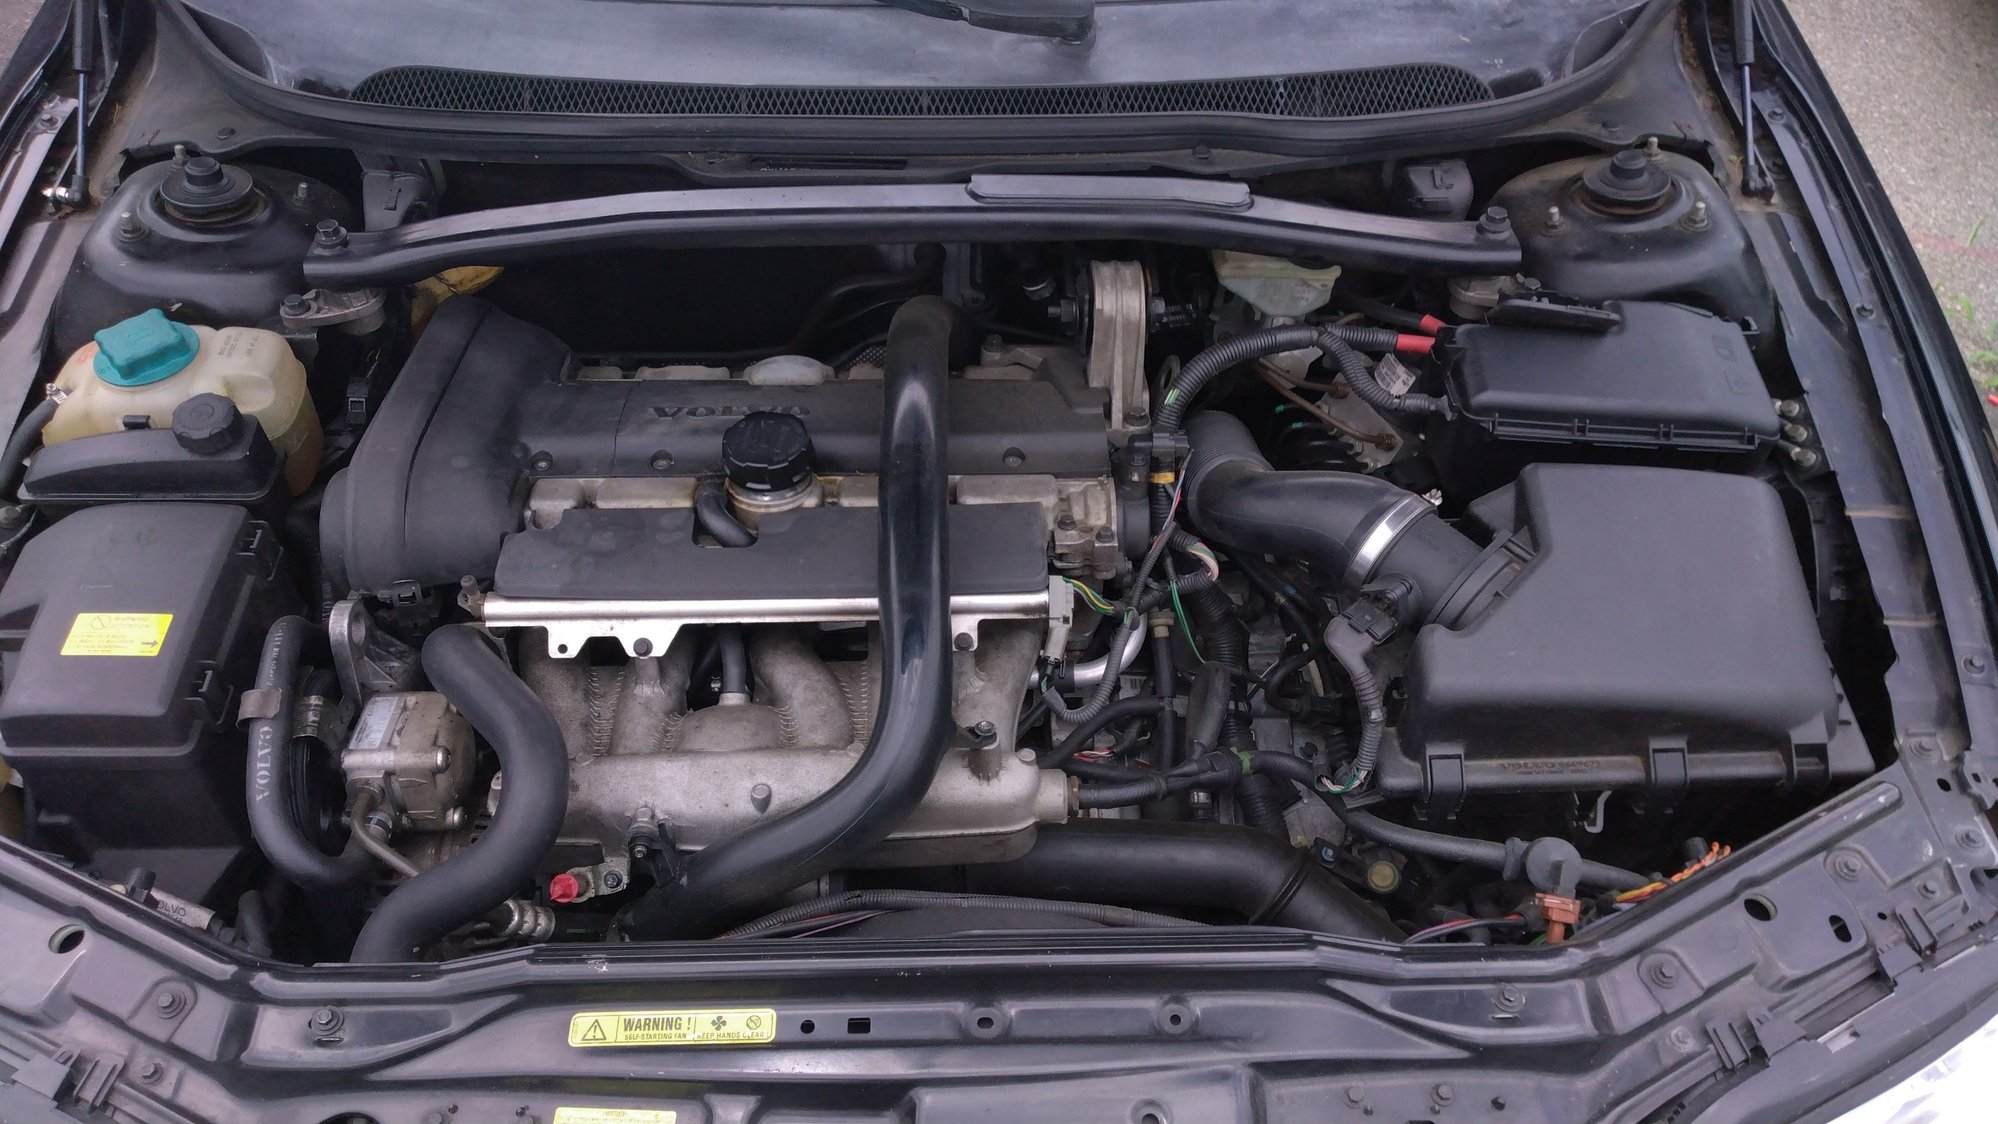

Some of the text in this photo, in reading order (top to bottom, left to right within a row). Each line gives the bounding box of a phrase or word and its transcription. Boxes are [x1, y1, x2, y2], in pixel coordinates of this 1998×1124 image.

[650, 405, 810, 418] VOLVO
[255, 726, 273, 803] VOLVO
[158, 900, 186, 917] OLVO
[623, 1016, 682, 1032] WARNING
[674, 1032, 687, 1040] FAN
[716, 1031, 740, 1039] HANDS
